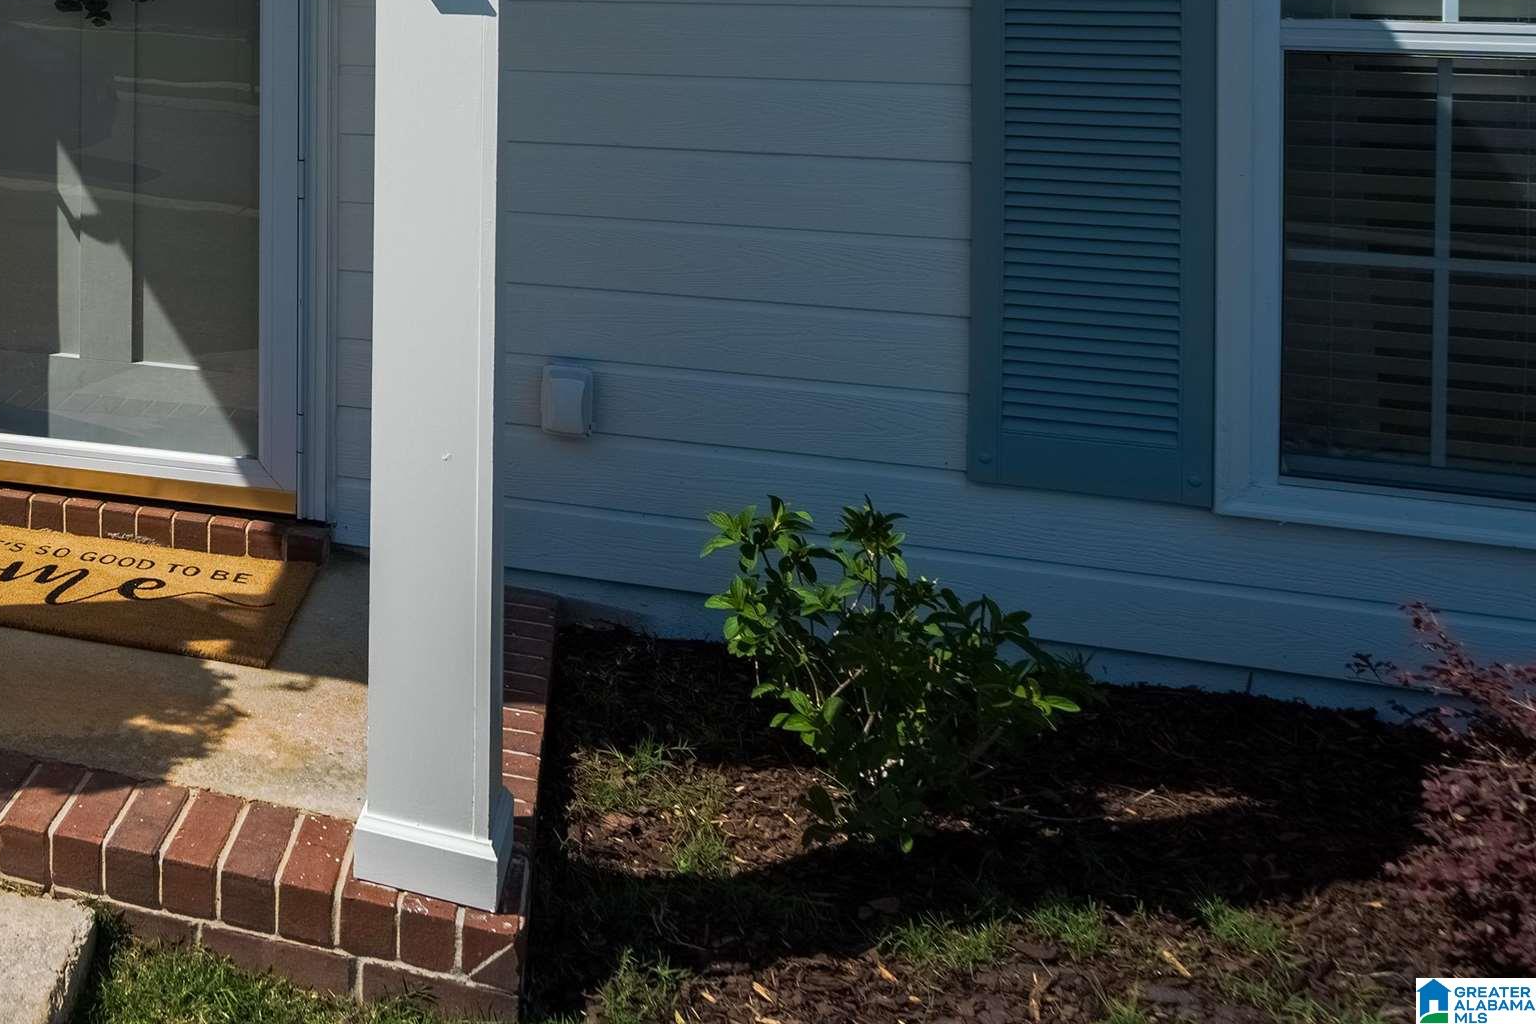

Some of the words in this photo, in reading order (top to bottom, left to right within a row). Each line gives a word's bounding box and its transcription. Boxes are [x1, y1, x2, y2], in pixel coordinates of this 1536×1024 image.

[35, 545, 71, 558] SO
[80, 551, 156, 570] GOOD
[167, 563, 201, 577] TO
[210, 570, 253, 585] BE
